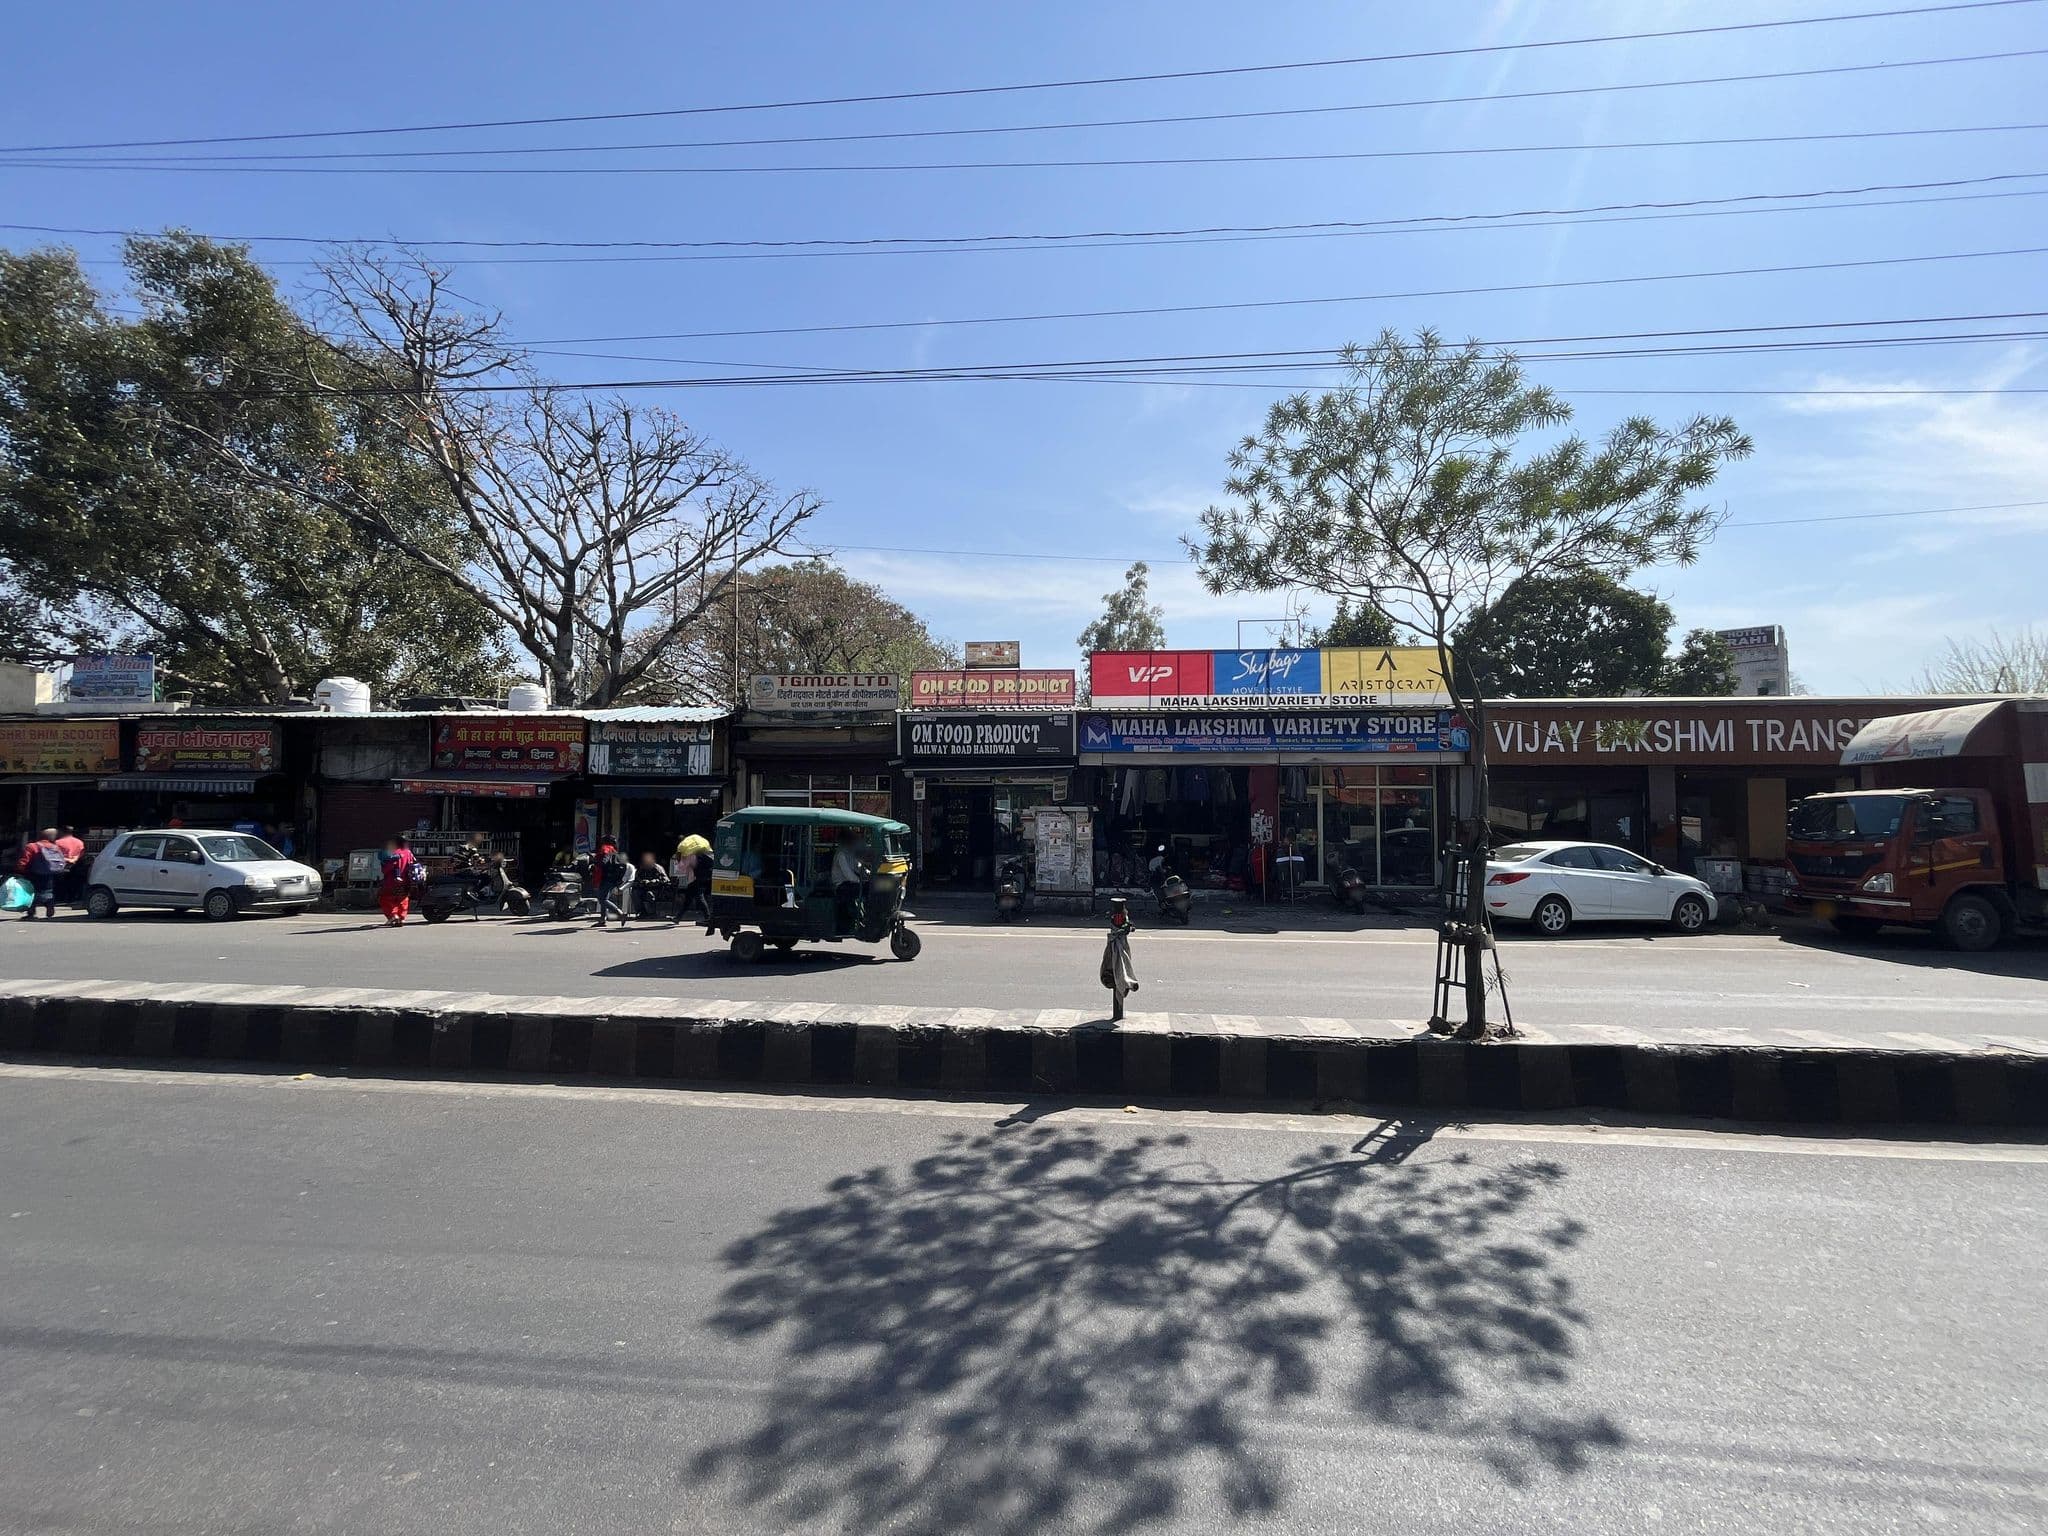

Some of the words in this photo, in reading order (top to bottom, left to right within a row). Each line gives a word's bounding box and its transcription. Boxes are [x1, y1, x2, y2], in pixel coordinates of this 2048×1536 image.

[1727, 629, 1765, 638] HOTEL
[1727, 635, 1768, 646] RAHI
[1231, 650, 1302, 684] Skybags
[1128, 666, 1173, 683] VIP
[919, 679, 944, 694] OM
[947, 679, 990, 694] FOOD
[993, 679, 1070, 694] PRODUCT
[1232, 687, 1258, 695] MOVE
[1276, 686, 1303, 694] STYLE
[1339, 679, 1435, 690] ARISTOCRAT
[1160, 697, 1200, 706] MAHA
[1203, 697, 1264, 706] LAKSHMI
[1268, 696, 1326, 705] VARIETY
[1331, 695, 1378, 705] STORE
[1111, 718, 1168, 736] MAHA
[1174, 718, 1265, 736] LAKSHMI
[1271, 717, 1361, 736] VARIETY
[1367, 717, 1437, 735] STORE
[0, 729, 25, 740] SHRI
[29, 729, 58, 740] BHIM
[62, 728, 118, 740] SCOOTER
[911, 724, 933, 743] OM
[936, 724, 973, 744] FOOD
[976, 724, 1041, 744] PRODUCT
[1492, 720, 1584, 752] VIJAY
[530, 748, 556, 760] डिनर
[913, 744, 949, 755] RAILWAY
[951, 744, 972, 755] ROAD
[973, 744, 1016, 755] HARIDWAR
